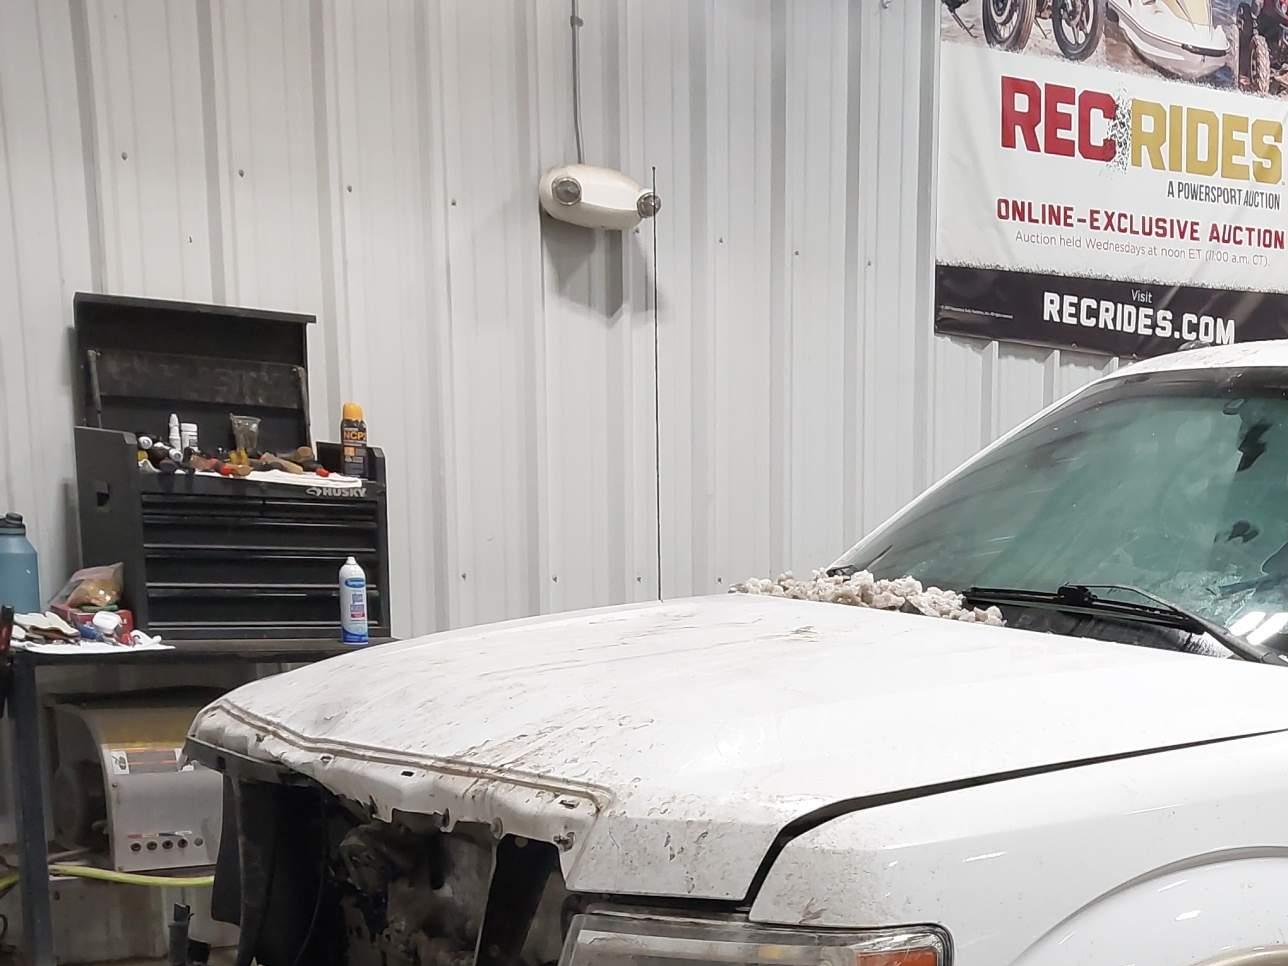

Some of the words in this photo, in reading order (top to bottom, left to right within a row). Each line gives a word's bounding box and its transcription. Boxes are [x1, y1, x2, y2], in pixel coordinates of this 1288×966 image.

[1001, 76, 1118, 162] REC
[1131, 98, 1284, 185] RIDES
[1167, 181, 1175, 198] A
[1178, 182, 1242, 206] POWERSPORT
[1243, 191, 1280, 210] AUCTION
[997, 198, 1200, 241] ONLINE-EXCLUSIVE
[1209, 223, 1285, 249] AUCTION
[1016, 230, 1057, 246] Auction
[1059, 233, 1082, 249] held
[1085, 237, 1146, 257] Wednesdays
[1148, 245, 1158, 256] at
[1161, 247, 1186, 259] noon
[1189, 249, 1202, 260] ET
[1131, 289, 1153, 304] Visit
[1043, 291, 1236, 345] RECRIDES.COM
[322, 487, 368, 498] HUSKY
